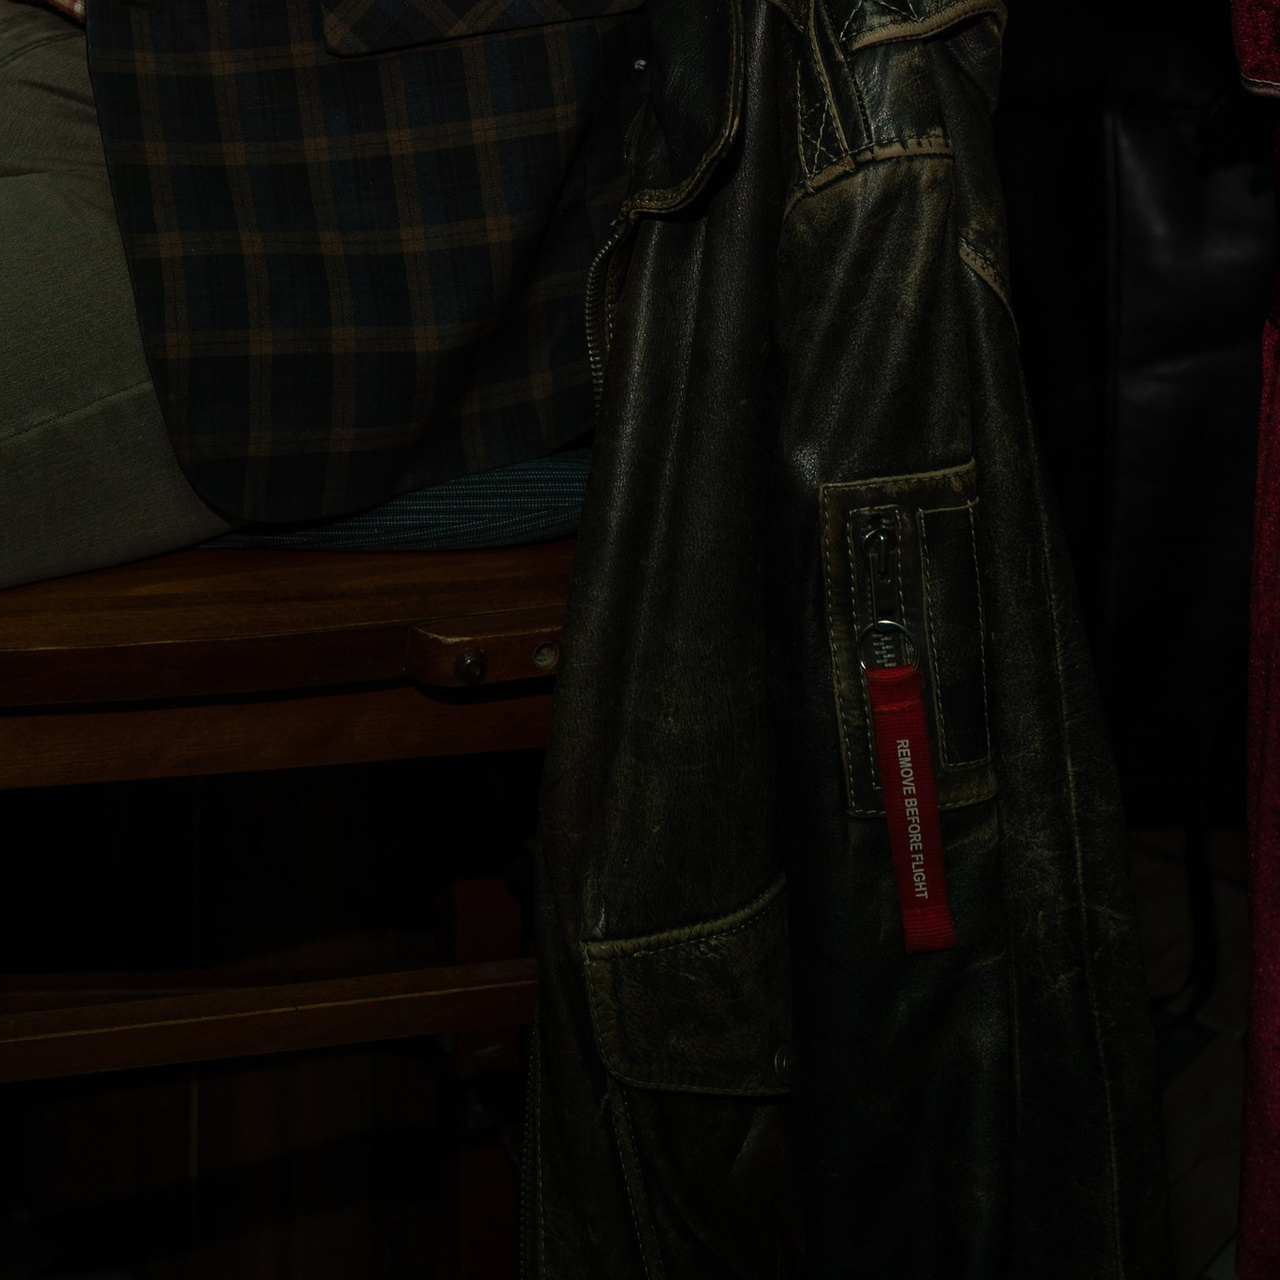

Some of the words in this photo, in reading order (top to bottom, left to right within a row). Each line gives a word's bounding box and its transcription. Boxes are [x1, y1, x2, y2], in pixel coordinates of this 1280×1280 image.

[896, 739, 916, 796] REMOVE
[904, 798, 923, 851] BEFORE
[910, 853, 928, 899] FLIGHT
